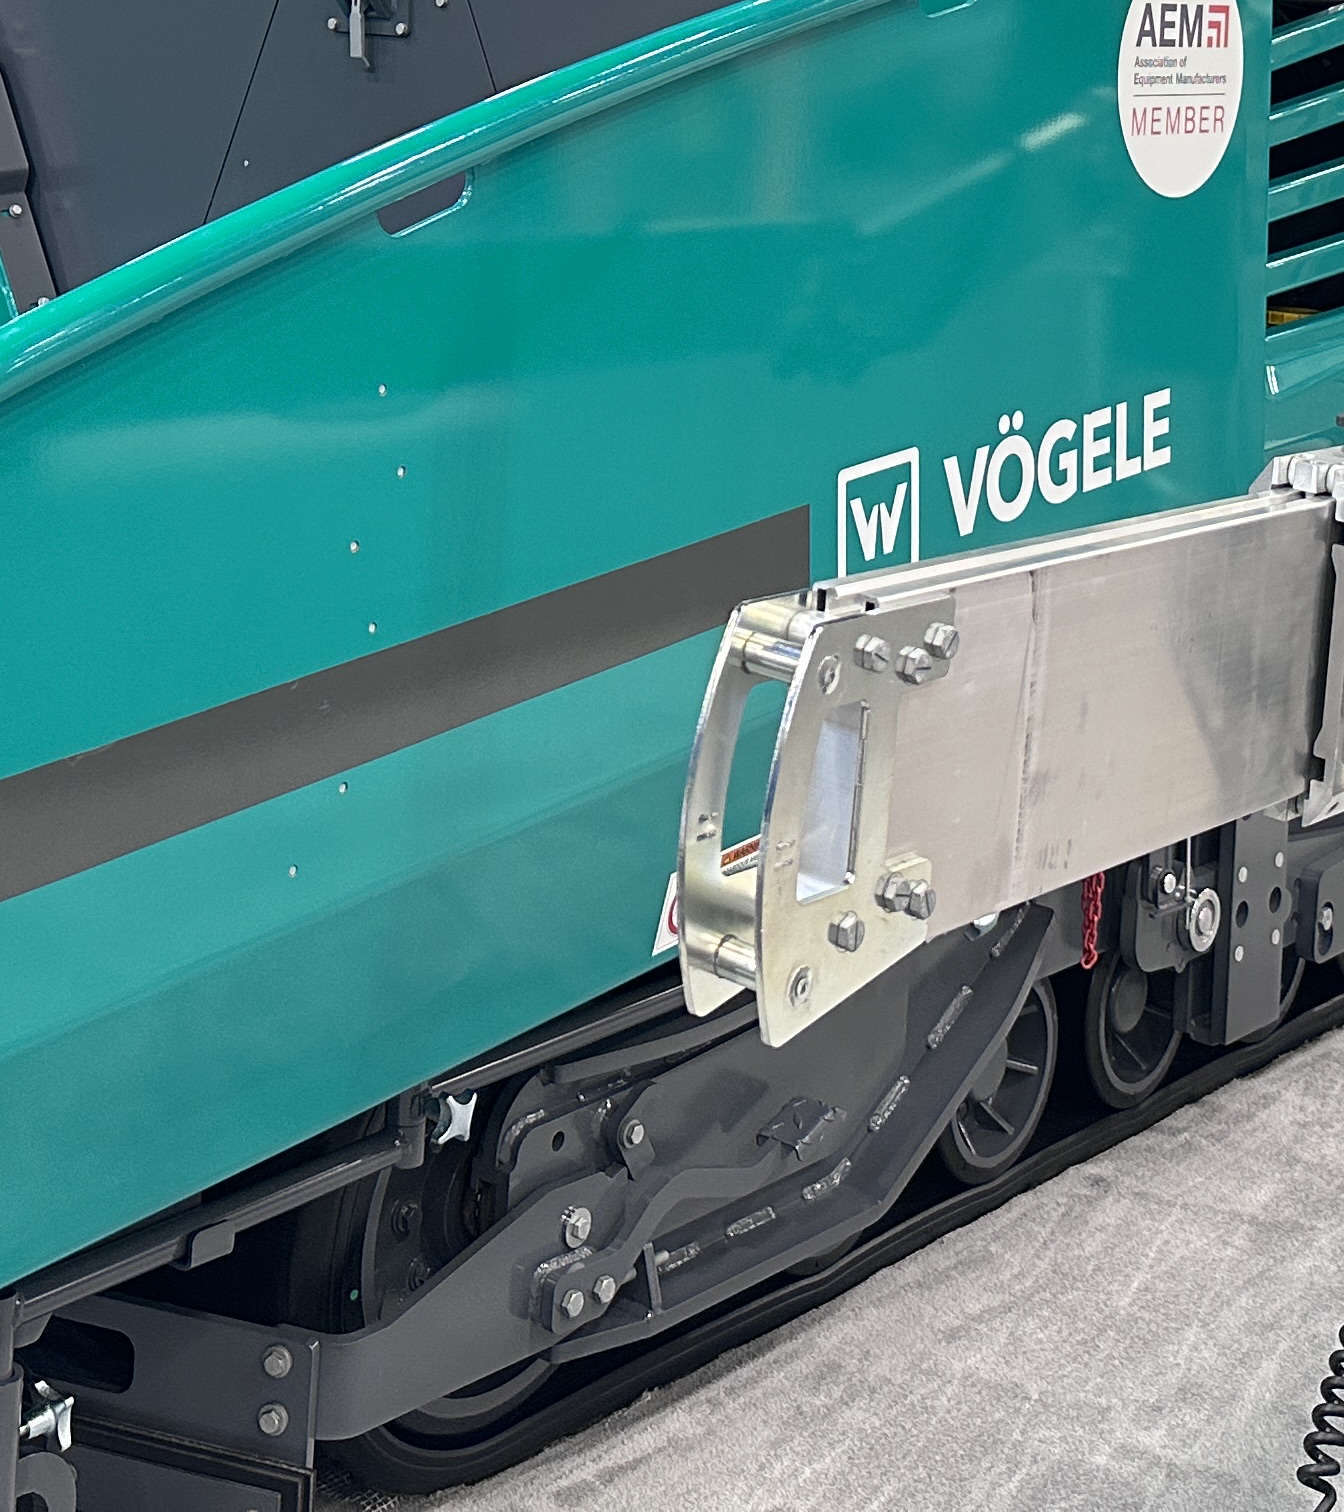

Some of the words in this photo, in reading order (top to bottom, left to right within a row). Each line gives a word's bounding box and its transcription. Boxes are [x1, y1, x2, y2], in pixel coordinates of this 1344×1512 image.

[1136, 2, 1204, 48] AEM
[1134, 56, 1178, 68] Association
[1179, 56, 1188, 68] of
[1133, 72, 1173, 87] Equipment
[1175, 72, 1227, 85] Manufacturers
[1131, 105, 1225, 136] MEMBER
[944, 388, 1171, 536] VÖGELE
